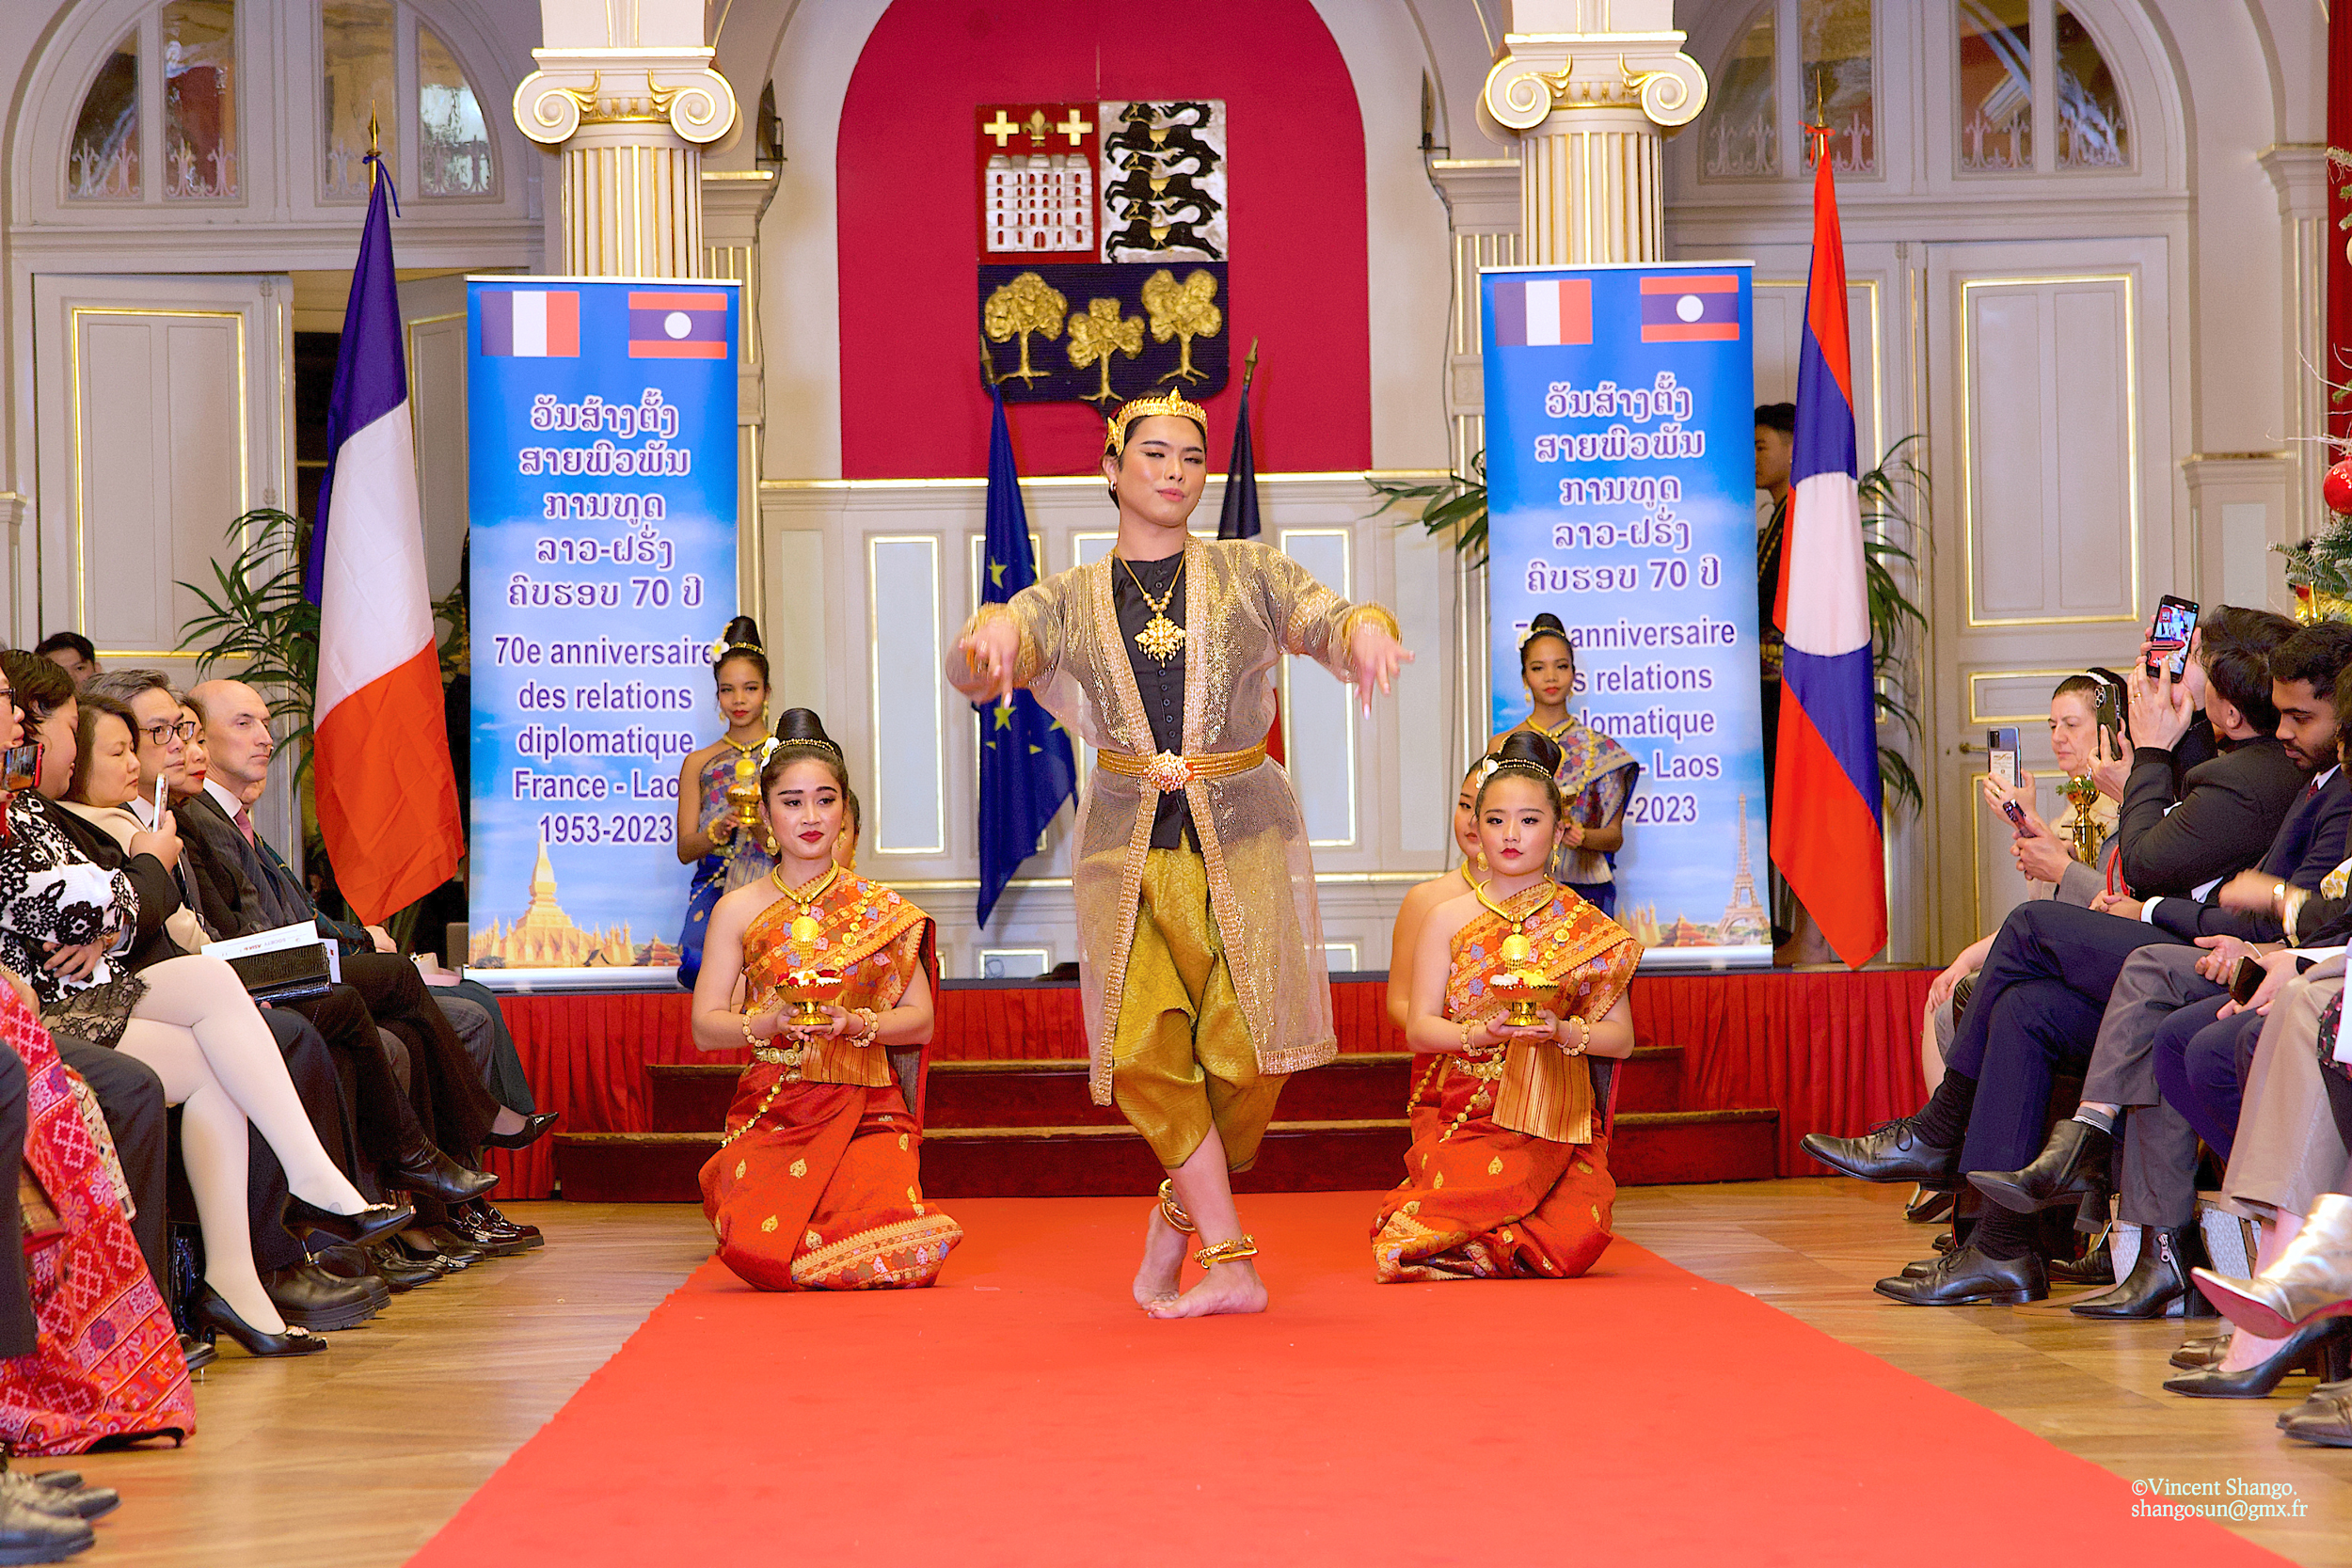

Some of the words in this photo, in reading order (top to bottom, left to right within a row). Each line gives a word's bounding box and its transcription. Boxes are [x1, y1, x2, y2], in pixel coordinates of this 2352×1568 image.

[1548, 373, 1692, 420] ວັນສ້າງຕັ້ງ
[533, 390, 679, 436] ວັນສ້າງຕັ້ງ
[1536, 426, 1704, 459] ສາຍພົວພັນ
[520, 442, 689, 474] ສາຍພົວພັນ
[1562, 478, 1680, 508] ການທູດ
[545, 495, 664, 526] ການທູດ
[1527, 561, 1637, 592] ຄົບຮອບ
[1650, 561, 1687, 588] 70
[1700, 557, 1721, 588] ປີ
[509, 575, 617, 606] ຄົບຮອບ
[632, 578, 669, 606] 70
[683, 576, 702, 607] ປີ
[1570, 618, 1736, 648] anniversaire
[495, 637, 541, 664] 70e
[550, 637, 711, 664] anniversaire
[1597, 664, 1712, 691] relations
[519, 681, 565, 709] des
[577, 682, 691, 709] relations
[1572, 707, 1715, 741] lomatique
[518, 725, 693, 761] diplomatique
[1656, 752, 1719, 778] Laos
[516, 770, 606, 799] France
[633, 771, 680, 800] Lao
[1625, 795, 1696, 824] -2023
[540, 816, 673, 843] 1953-2023
